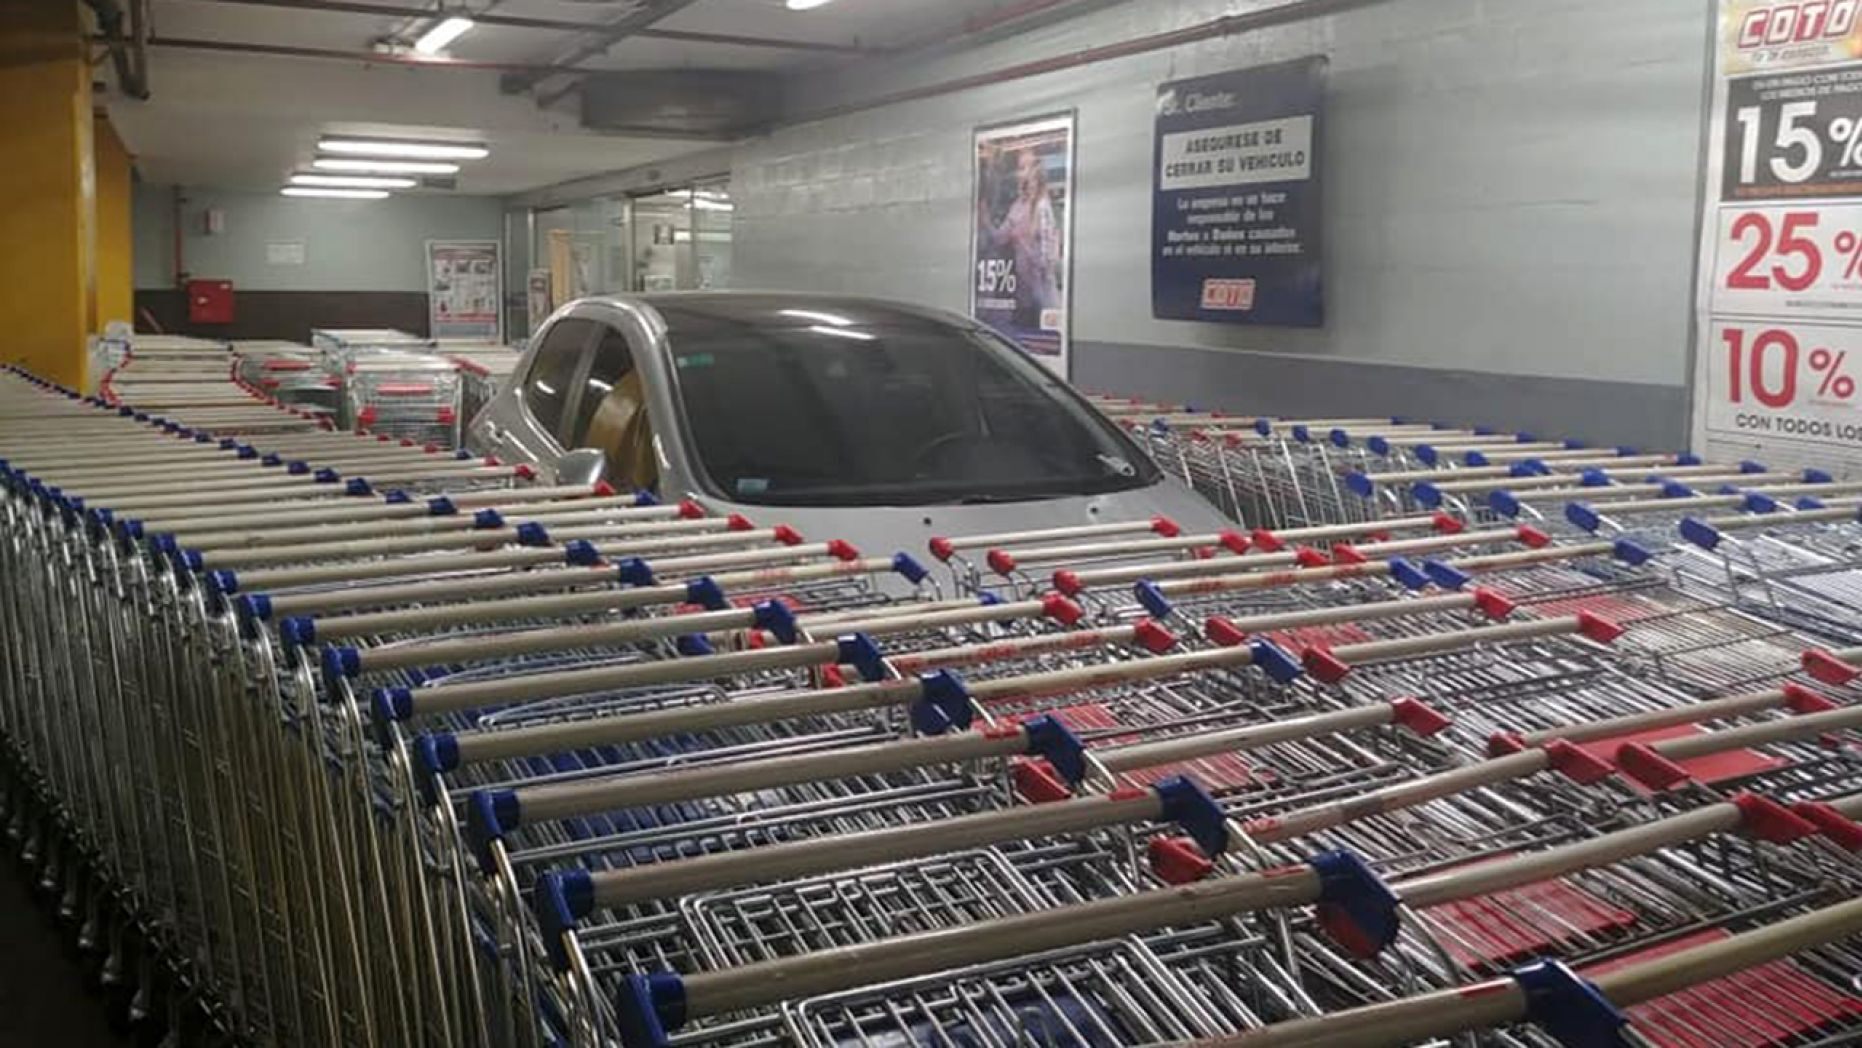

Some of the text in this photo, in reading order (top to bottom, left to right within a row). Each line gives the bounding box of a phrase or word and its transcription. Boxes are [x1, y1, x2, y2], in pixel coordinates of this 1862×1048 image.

[1738, 0, 1857, 48] COTO
[1185, 128, 1283, 154] ASEGURESE DE
[1165, 150, 1305, 178] CERRAR SU VEHICULO
[977, 258, 1017, 293] 15%
[1736, 414, 1770, 430] CON
[1776, 417, 1832, 437] TODOS
